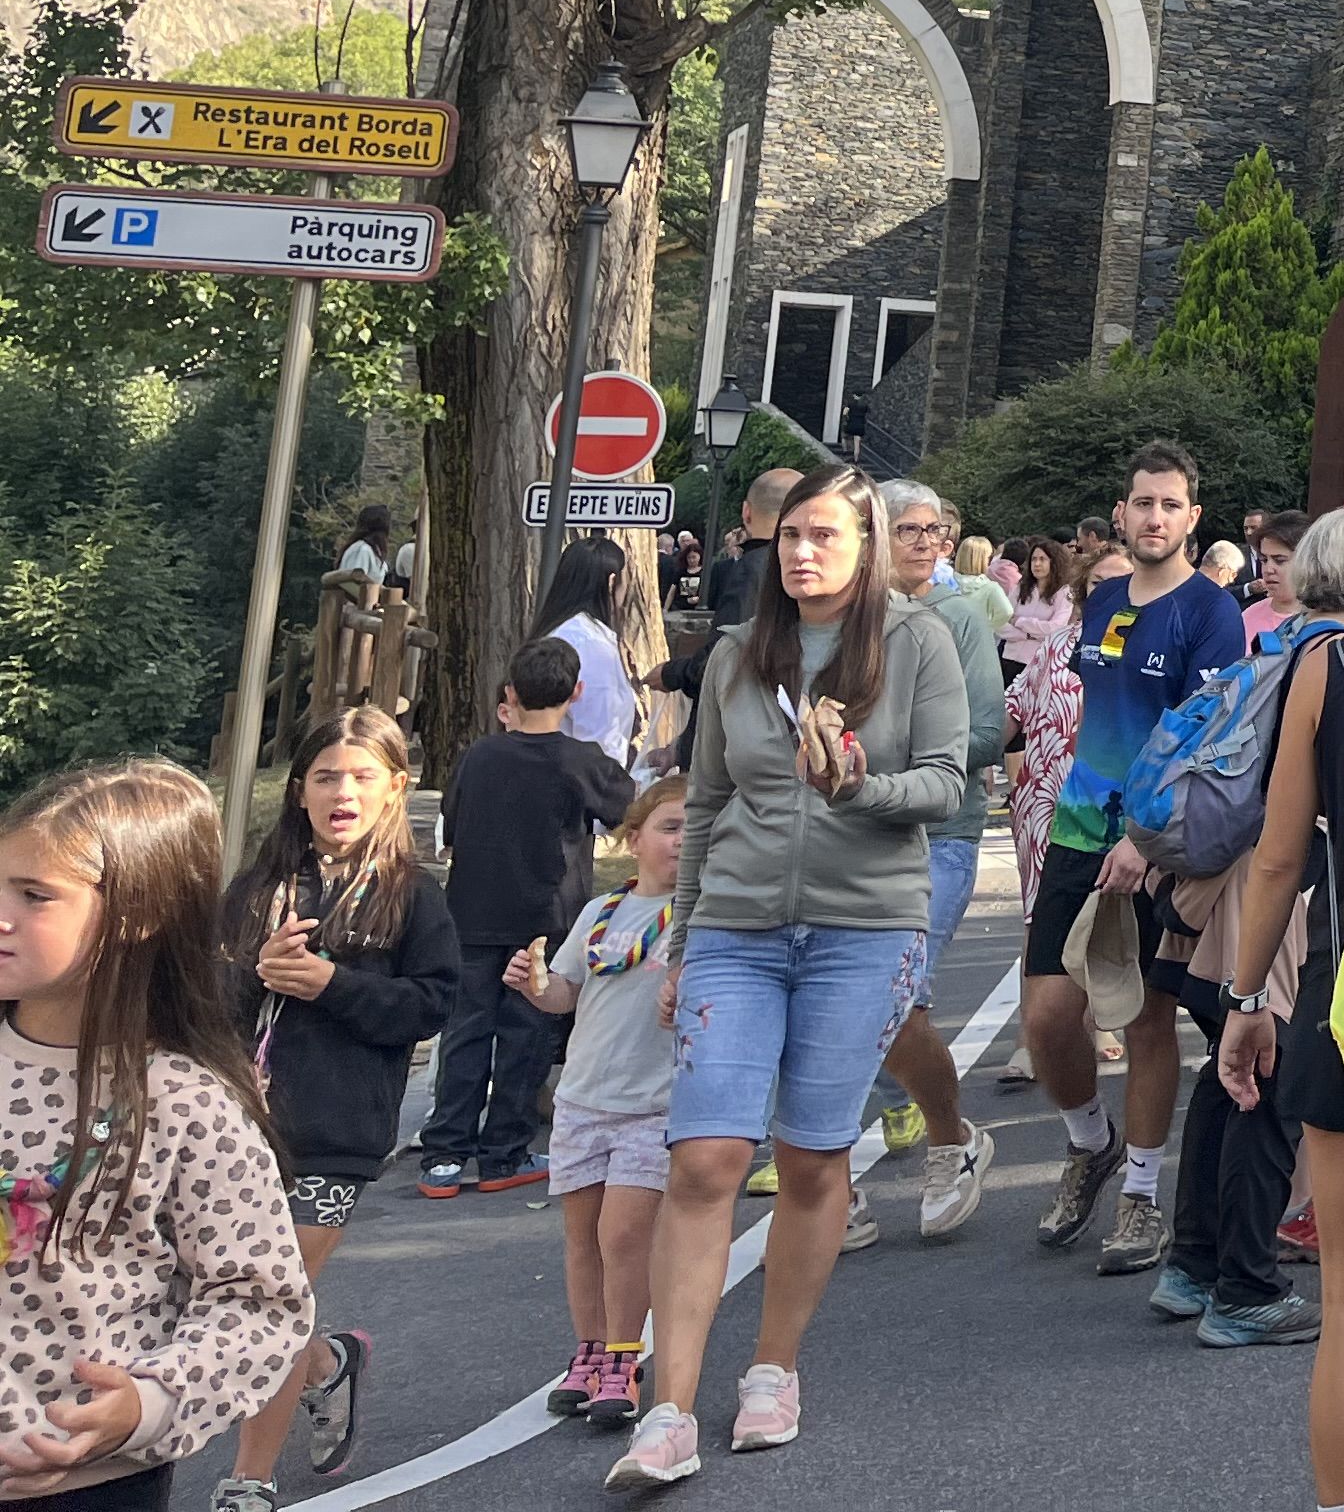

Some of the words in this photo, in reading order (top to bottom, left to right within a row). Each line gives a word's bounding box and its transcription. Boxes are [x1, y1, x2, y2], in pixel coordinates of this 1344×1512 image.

[193, 101, 348, 132] Restaurant
[356, 113, 434, 137] Borda
[217, 127, 288, 152] L'Era
[298, 135, 340, 155] del
[348, 137, 431, 161] Rosell
[119, 211, 150, 243] P
[290, 215, 419, 247] Pàrquing
[287, 242, 417, 266] autocars
[536, 494, 609, 515] EEPTE
[615, 490, 661, 516] VEÏNS
